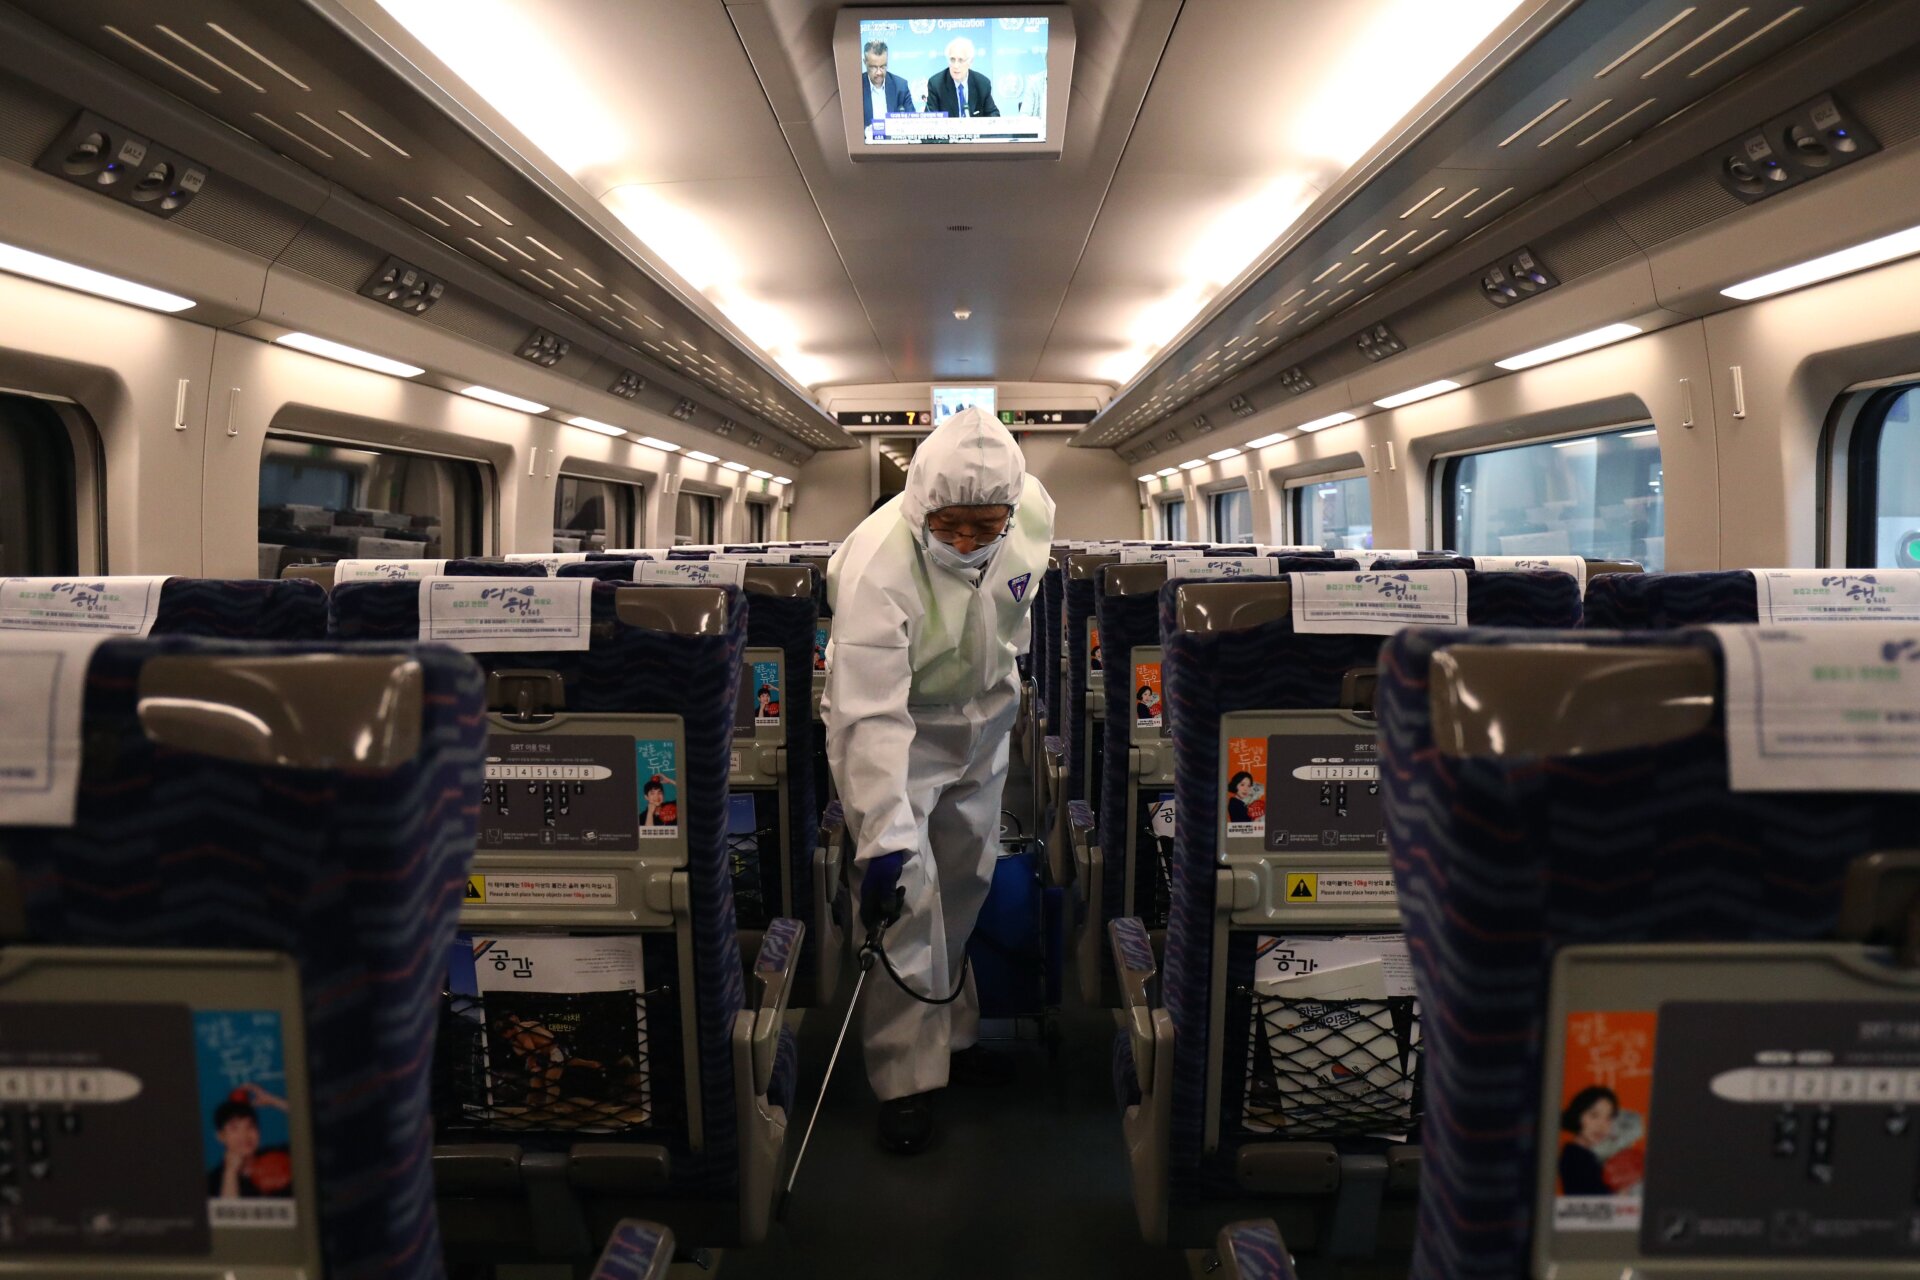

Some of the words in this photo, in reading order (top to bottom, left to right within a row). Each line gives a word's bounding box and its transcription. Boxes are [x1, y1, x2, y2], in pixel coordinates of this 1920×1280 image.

[938, 19, 985, 31] Organization
[905, 411, 916, 425] 7
[51, 583, 99, 611] 여행
[1355, 574, 1408, 600] 여행
[1822, 576, 1875, 604] 여행
[481, 587, 531, 616] 여행
[647, 757, 676, 774] 듀오
[1237, 753, 1267, 773] 듀오
[488, 949, 533, 978] 공감
